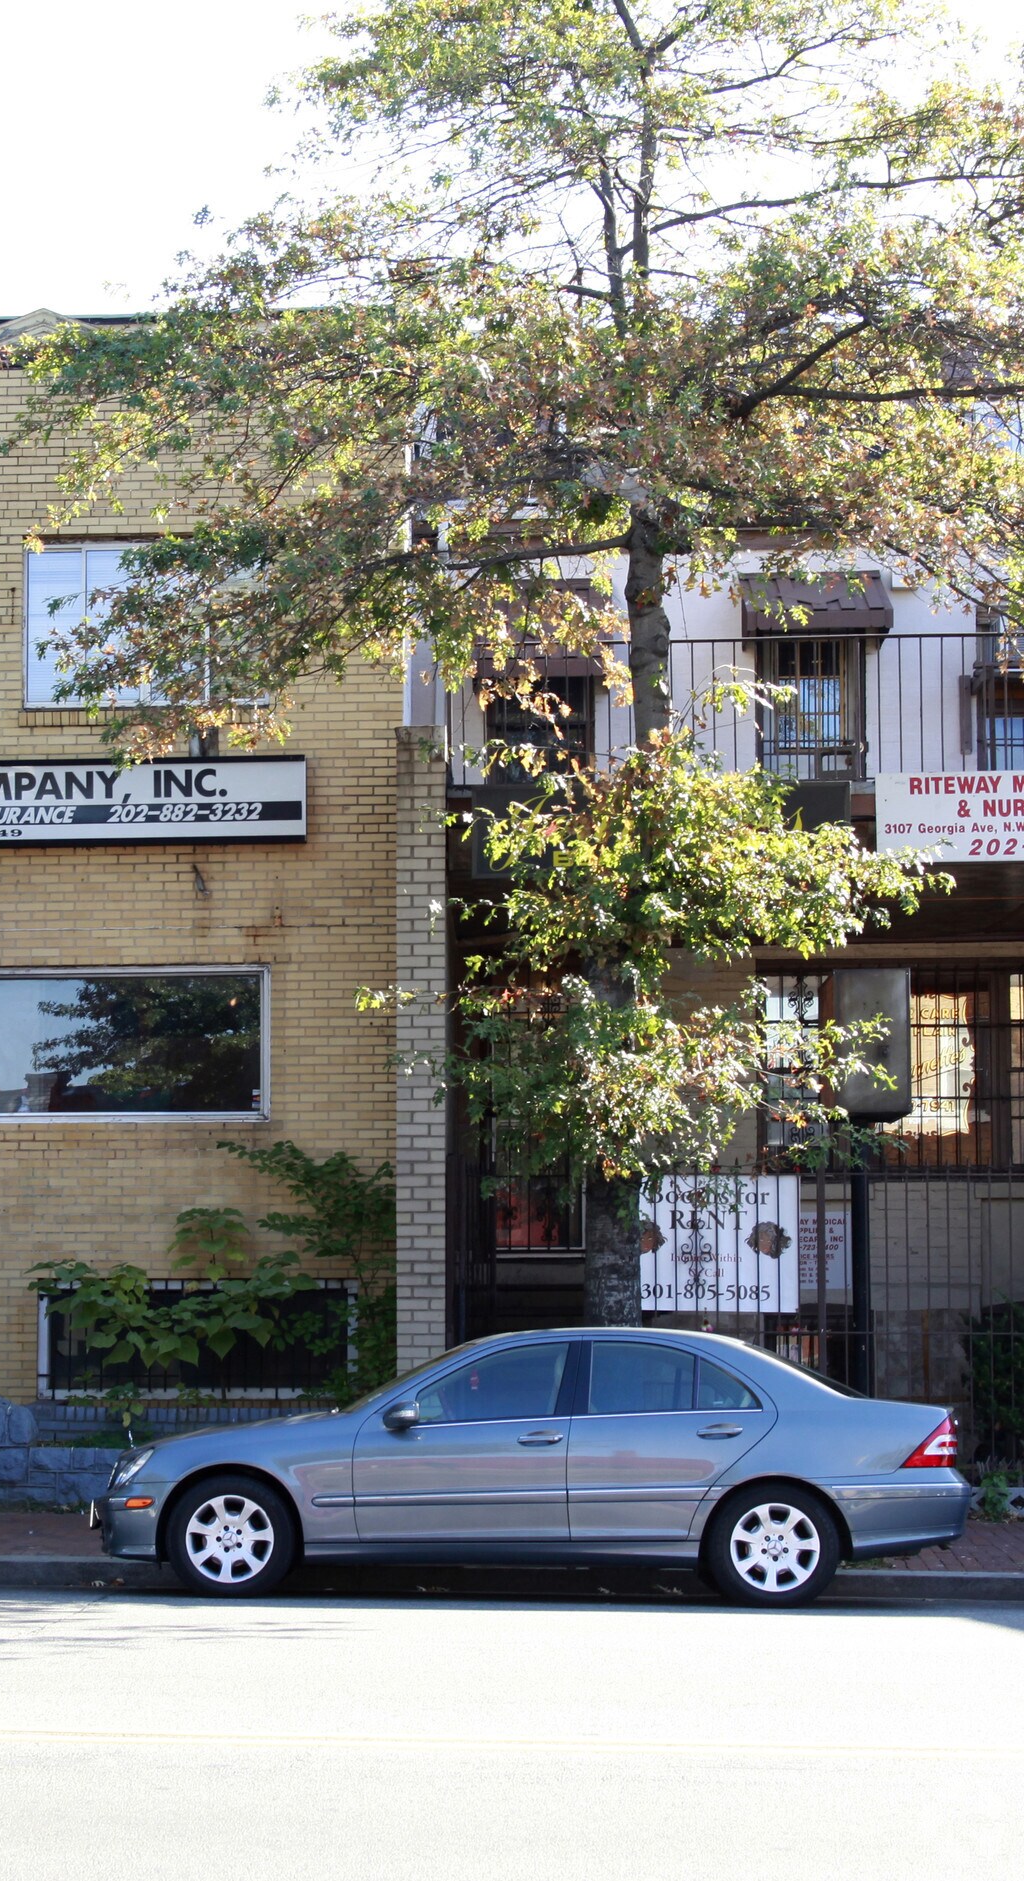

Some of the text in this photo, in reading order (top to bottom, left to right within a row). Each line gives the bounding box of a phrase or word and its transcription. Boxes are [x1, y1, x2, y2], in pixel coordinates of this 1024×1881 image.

[153, 768, 227, 798] INC.
[909, 776, 1002, 795] RITEWAY
[109, 803, 262, 823] 202-882-3232
[957, 800, 971, 818] &
[884, 823, 913, 834] 3107
[918, 822, 965, 835] Georgia
[971, 822, 998, 834] Ave,
[920, 1008, 959, 1019] CARE
[668, 1210, 748, 1231] RENT
[710, 1253, 742, 1263] Within
[704, 1268, 724, 1278] Call
[640, 1283, 771, 1301] 301-805-5085
